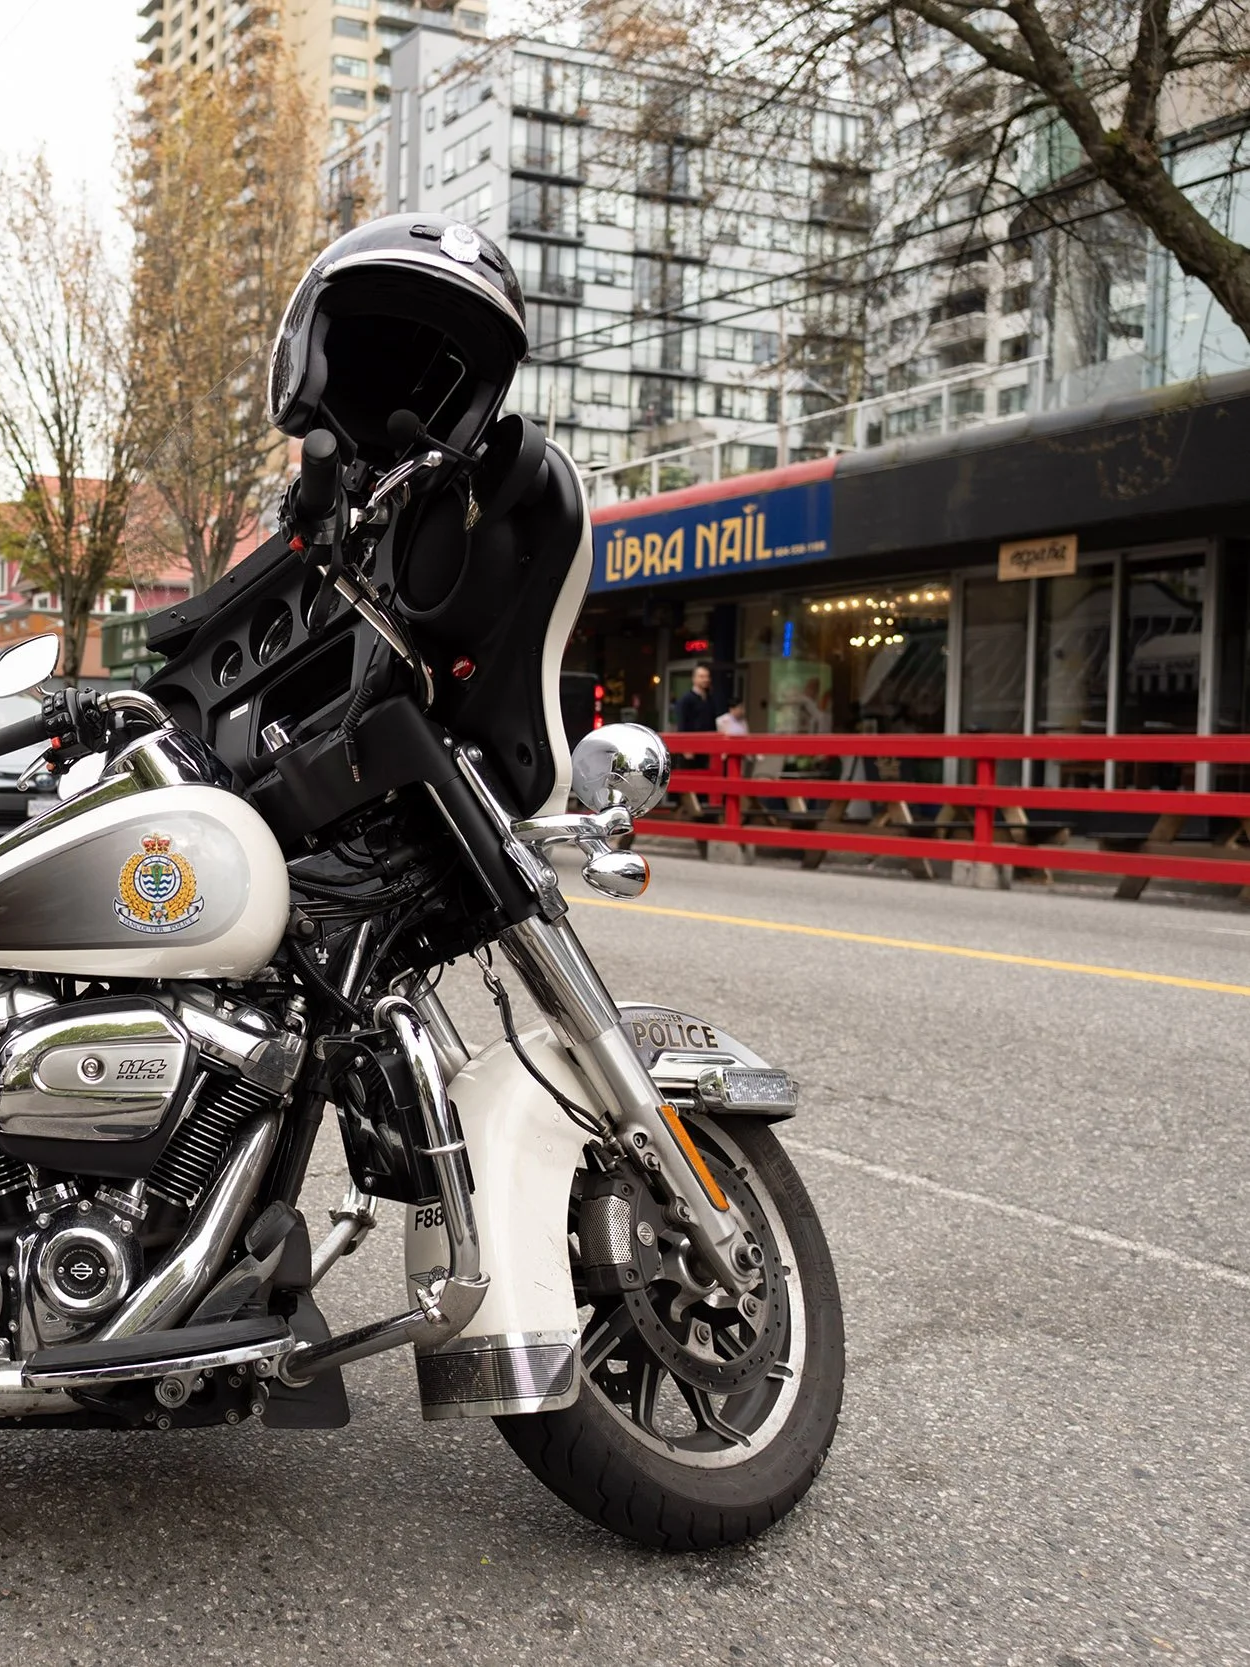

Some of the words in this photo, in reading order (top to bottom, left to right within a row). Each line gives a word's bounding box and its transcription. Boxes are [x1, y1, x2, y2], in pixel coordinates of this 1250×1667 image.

[123, 918, 164, 932] VANCOUVER
[170, 917, 193, 931] POLICE
[631, 1012, 683, 1023] VANCOUVER
[632, 1021, 719, 1048] POLICE
[118, 1059, 168, 1074] 114
